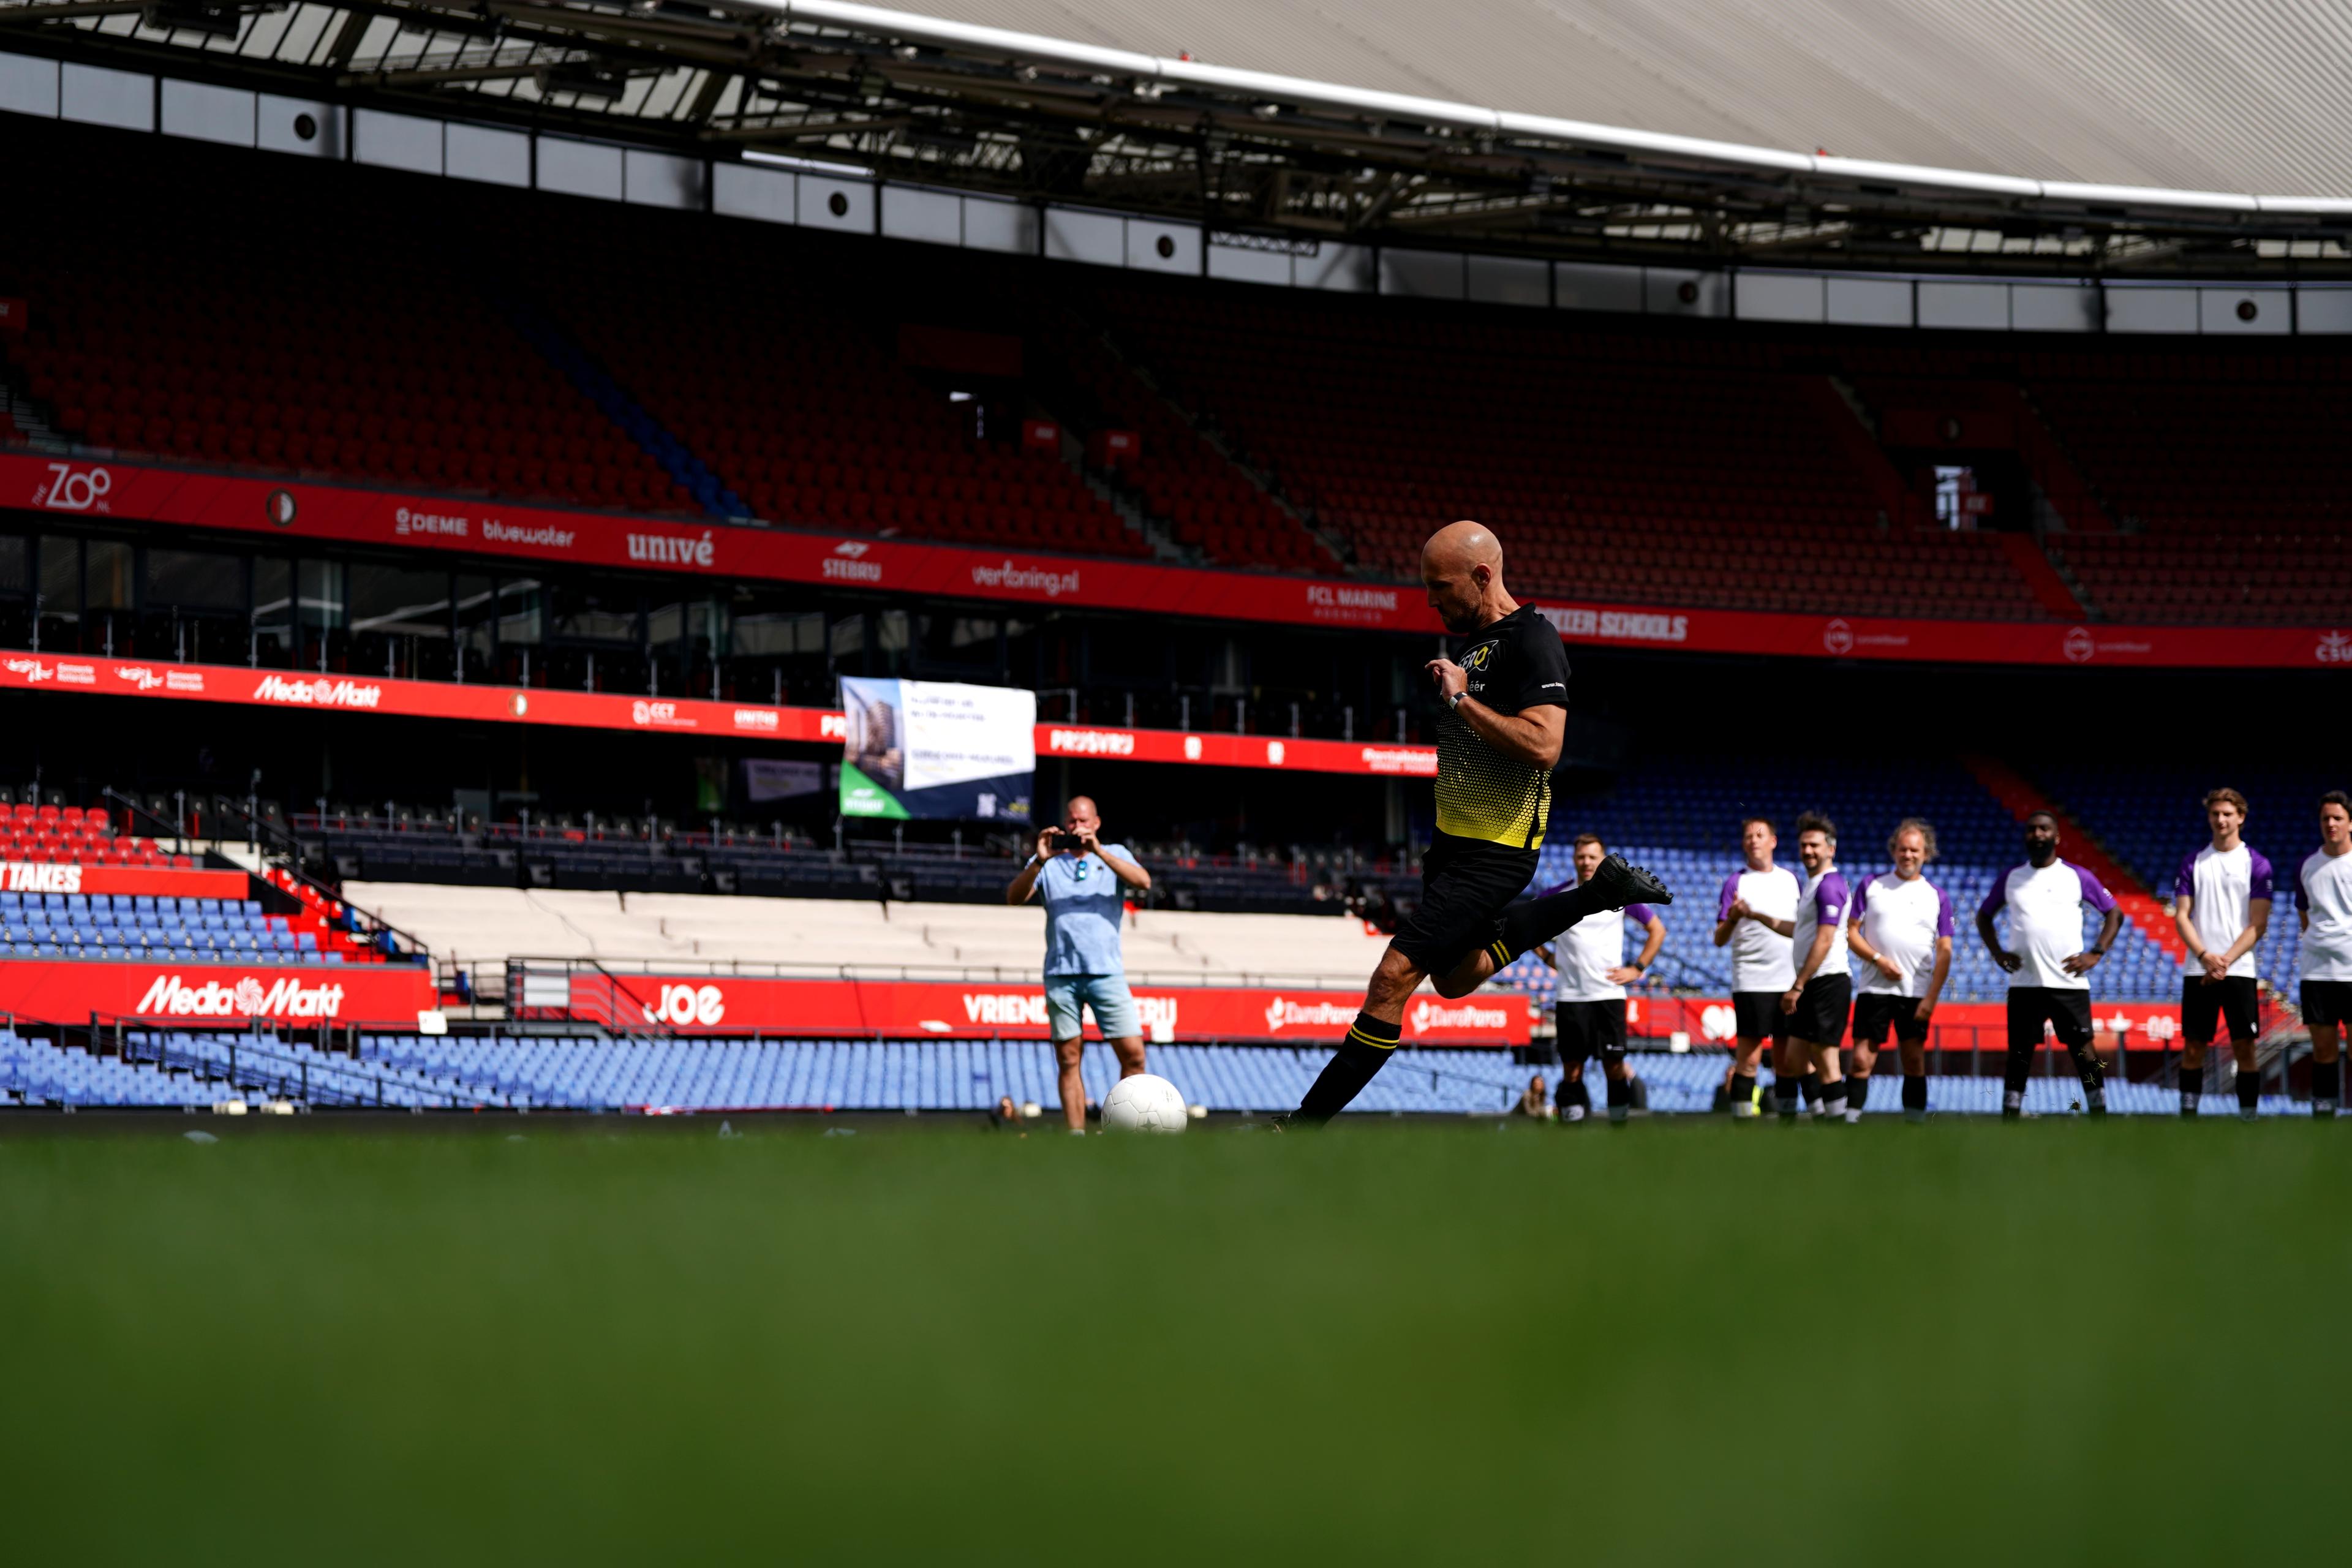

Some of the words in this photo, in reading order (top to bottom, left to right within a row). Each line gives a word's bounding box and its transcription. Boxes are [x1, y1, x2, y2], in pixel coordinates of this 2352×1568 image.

[412, 513, 468, 537] DEME
[483, 518, 575, 548] bluewater
[823, 558, 882, 582] STEBRU
[1306, 586, 1336, 606] FCL
[1336, 588, 1398, 611] MARINE
[1599, 611, 1689, 641] SCHOOLS
[8, 862, 82, 893] TAKES
[1429, 1005, 1507, 1028] EuroParcs
